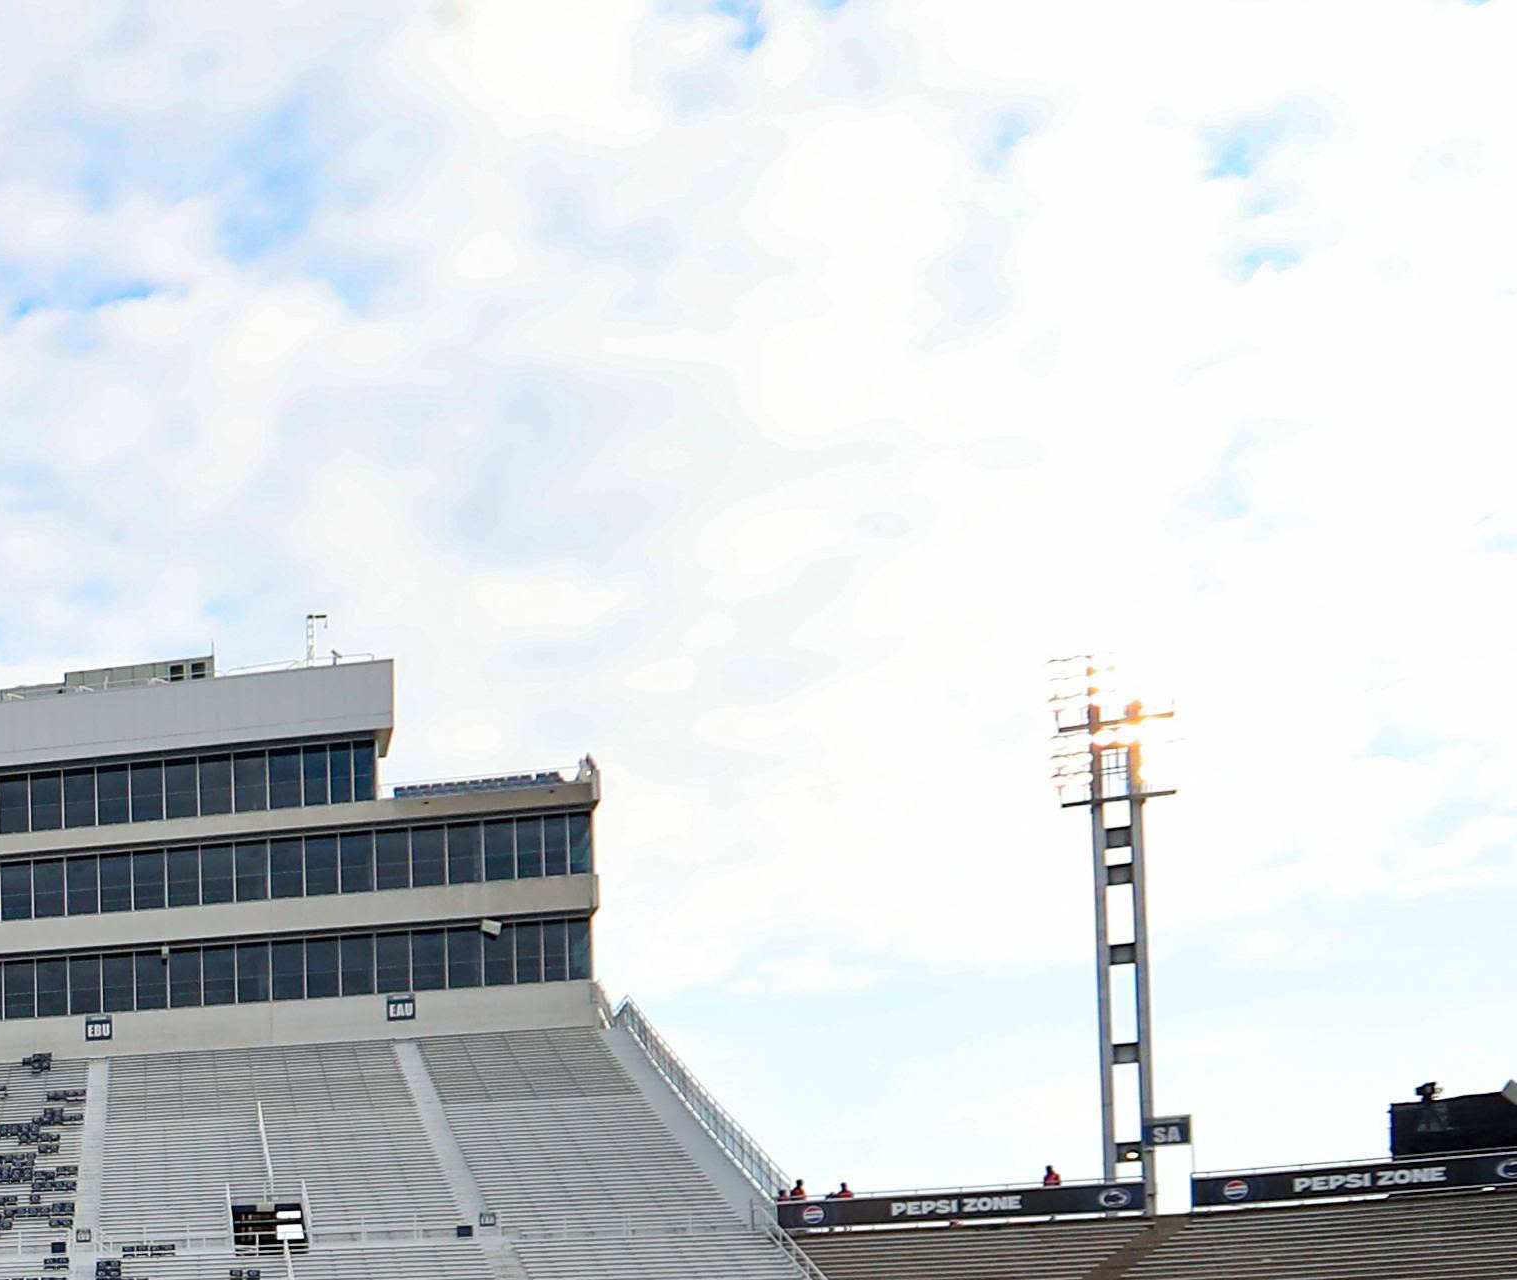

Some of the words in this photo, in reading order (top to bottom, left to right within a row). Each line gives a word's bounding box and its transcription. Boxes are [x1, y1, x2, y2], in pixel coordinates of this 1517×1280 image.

[388, 1003, 414, 1017] EAU
[87, 1024, 111, 1037] EBU
[1153, 1126, 1182, 1143] SA
[1293, 1173, 1372, 1193] PEPSI
[1375, 1166, 1448, 1186] ZONE
[891, 1199, 959, 1217] PEPSI
[962, 1195, 1023, 1213] ZONE
